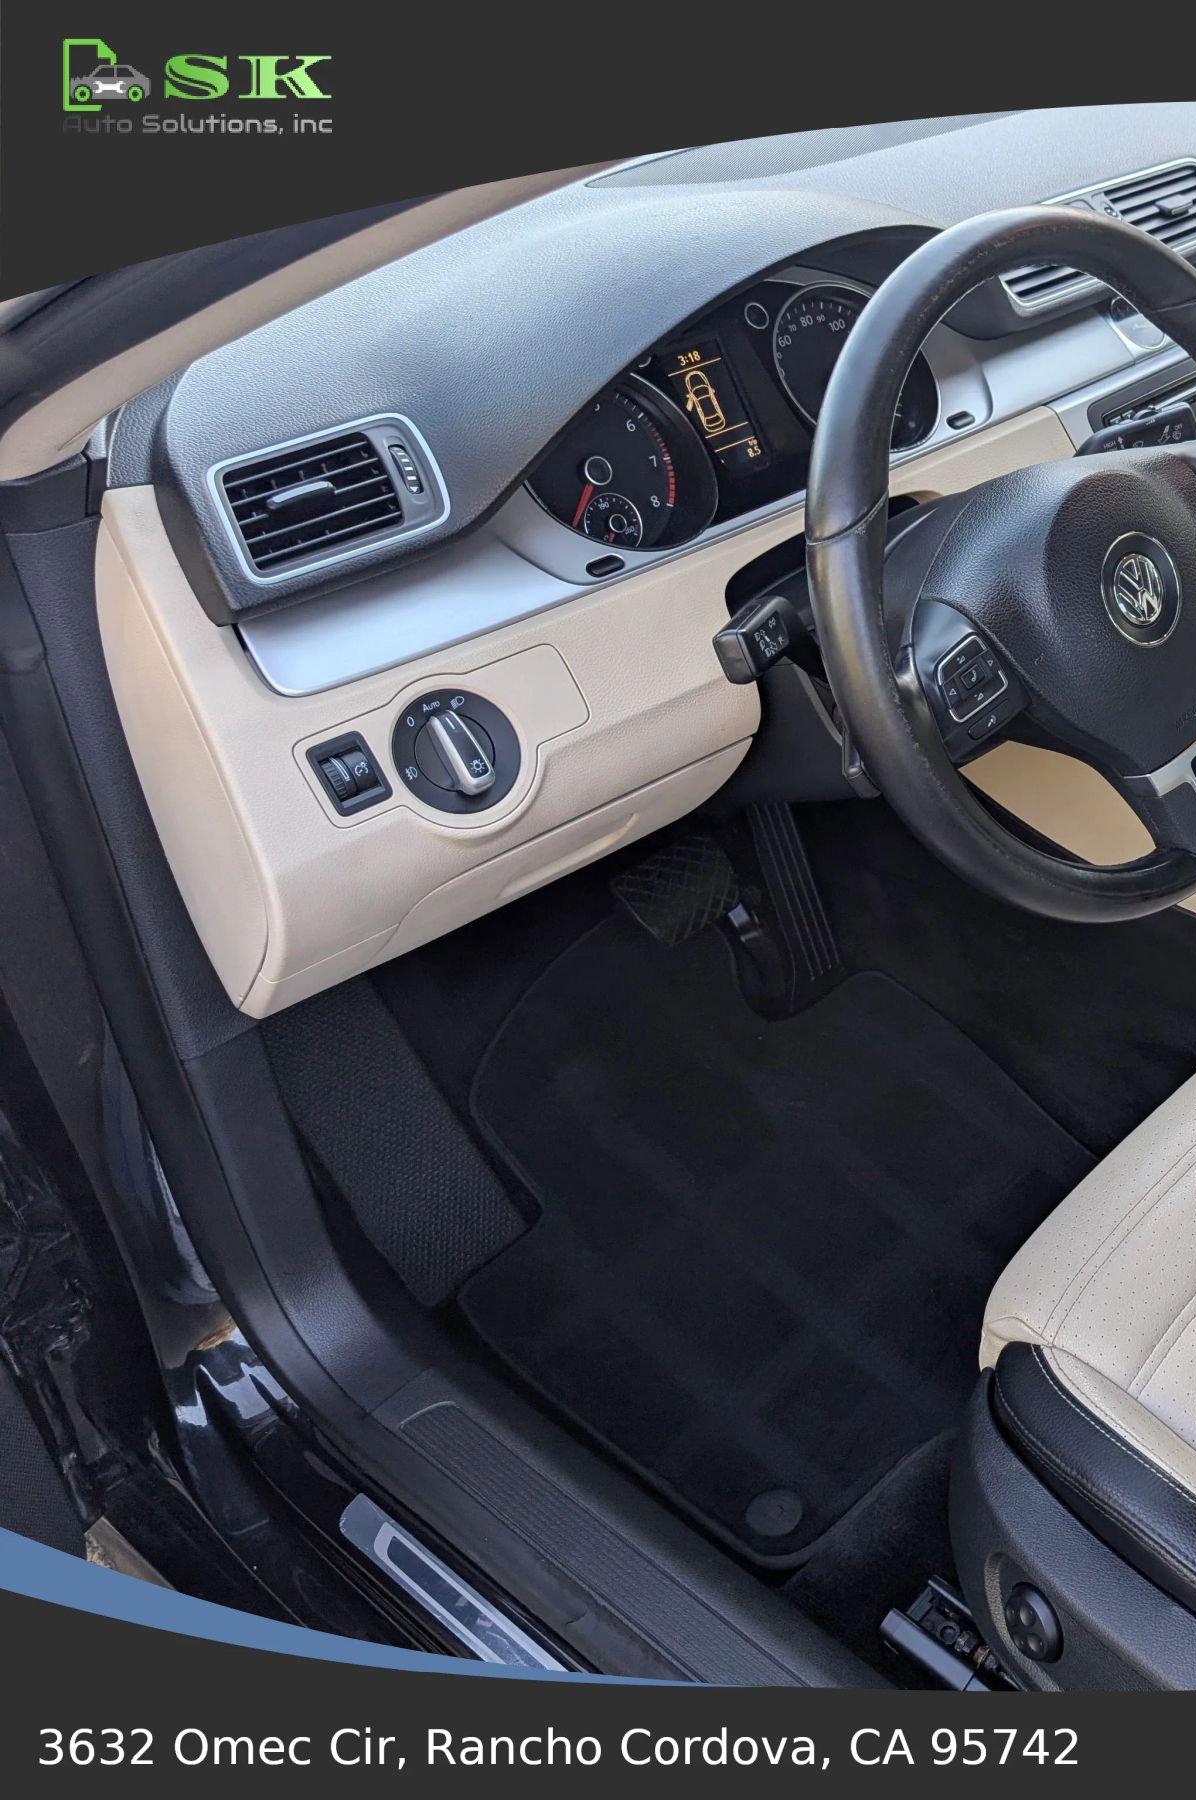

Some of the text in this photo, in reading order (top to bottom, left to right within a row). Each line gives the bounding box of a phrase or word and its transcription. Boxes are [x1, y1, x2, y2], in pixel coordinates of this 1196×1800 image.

[778, 335, 792, 347] 60
[800, 314, 814, 327] 80
[828, 318, 846, 332] 100
[677, 350, 701, 366] 3:18
[626, 419, 636, 432] 6
[747, 445, 761, 458] 8.5
[648, 455, 657, 468] 7
[650, 495, 661, 508] 8
